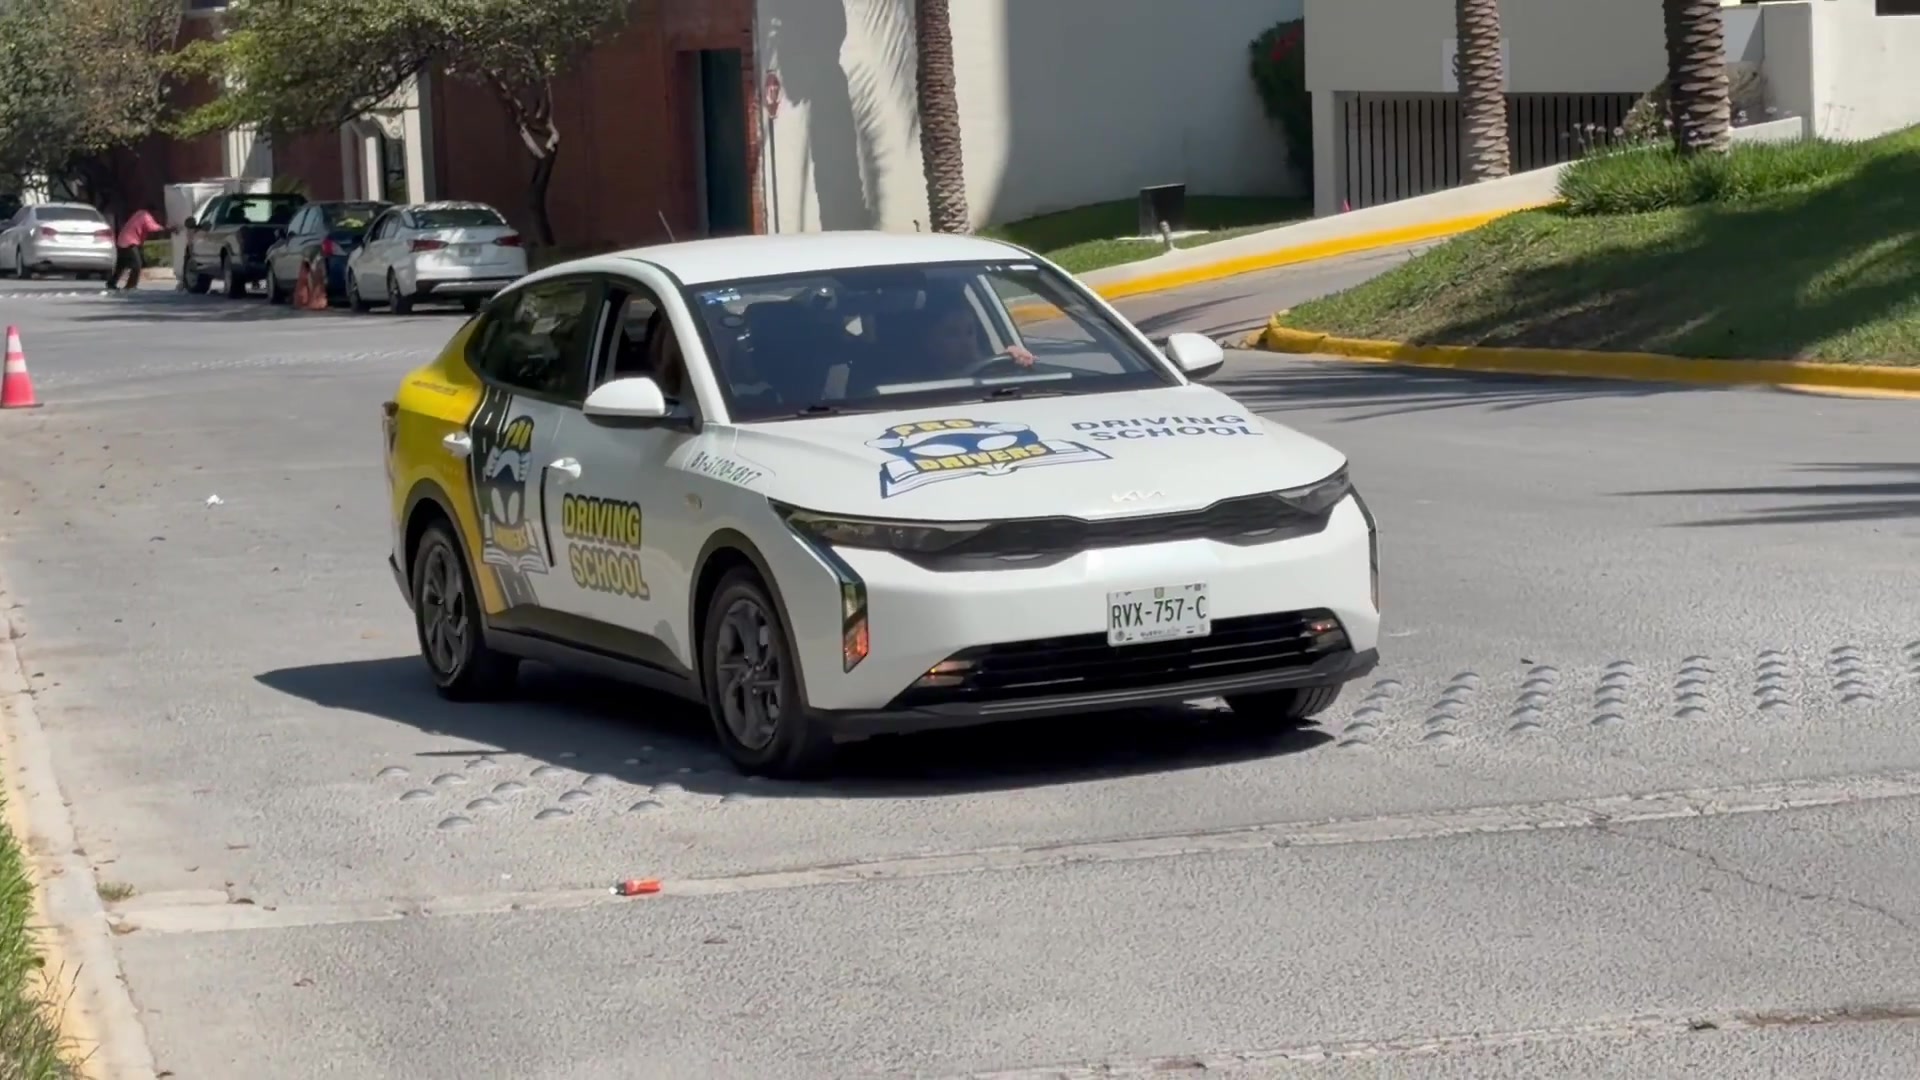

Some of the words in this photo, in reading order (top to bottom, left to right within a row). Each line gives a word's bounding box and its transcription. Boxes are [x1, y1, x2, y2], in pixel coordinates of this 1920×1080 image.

[892, 418, 974, 437] PRO
[1071, 415, 1247, 431] DRIVING
[1089, 426, 1264, 441] SCHOOL
[914, 444, 1048, 471] DRIVERS
[562, 493, 642, 551] DRIVING
[568, 537, 651, 602] SCHOOL
[1111, 594, 1207, 629] RVX-757-C
